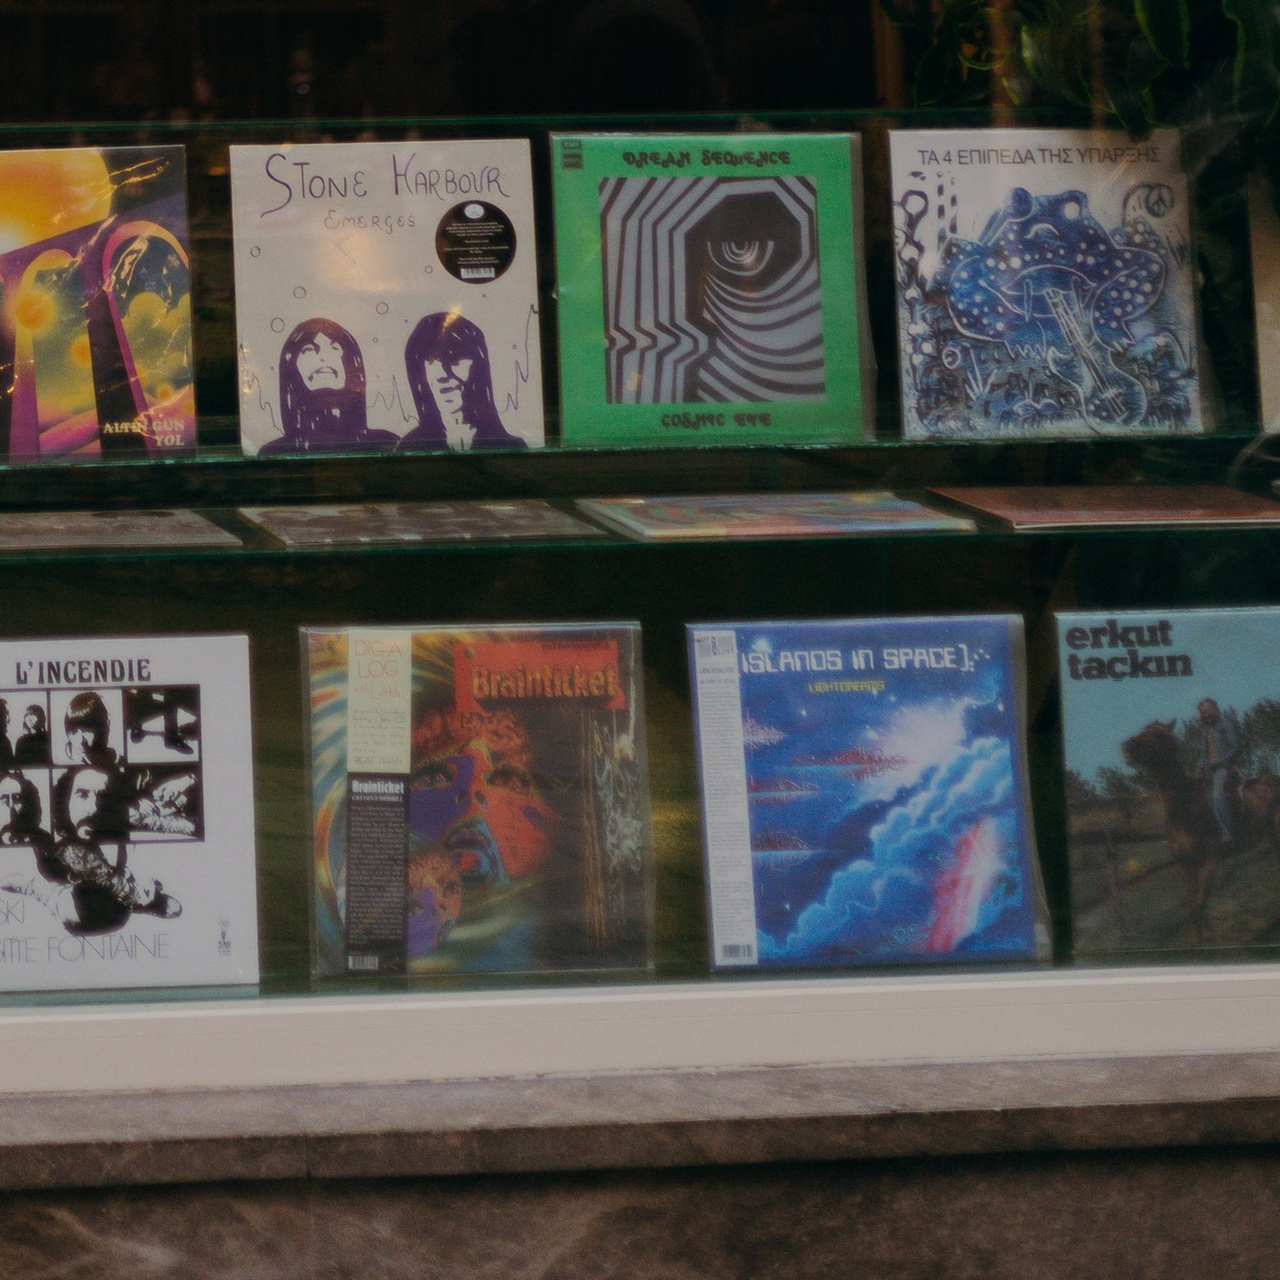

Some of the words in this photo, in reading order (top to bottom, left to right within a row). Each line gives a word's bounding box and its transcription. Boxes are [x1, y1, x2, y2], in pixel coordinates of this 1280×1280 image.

[918, 149, 940, 165] ΤΑ
[942, 149, 953, 165] 4
[1038, 147, 1074, 165] ΤΗΣ
[260, 153, 368, 218] STONE
[155, 434, 185, 446] YOL
[1065, 618, 1173, 651] erkut
[358, 659, 400, 678] LOG
[851, 648, 874, 671] IN
[472, 664, 617, 699] Brainticket
[351, 780, 405, 795] Brainticket
[47, 932, 170, 963] FONTAINE
